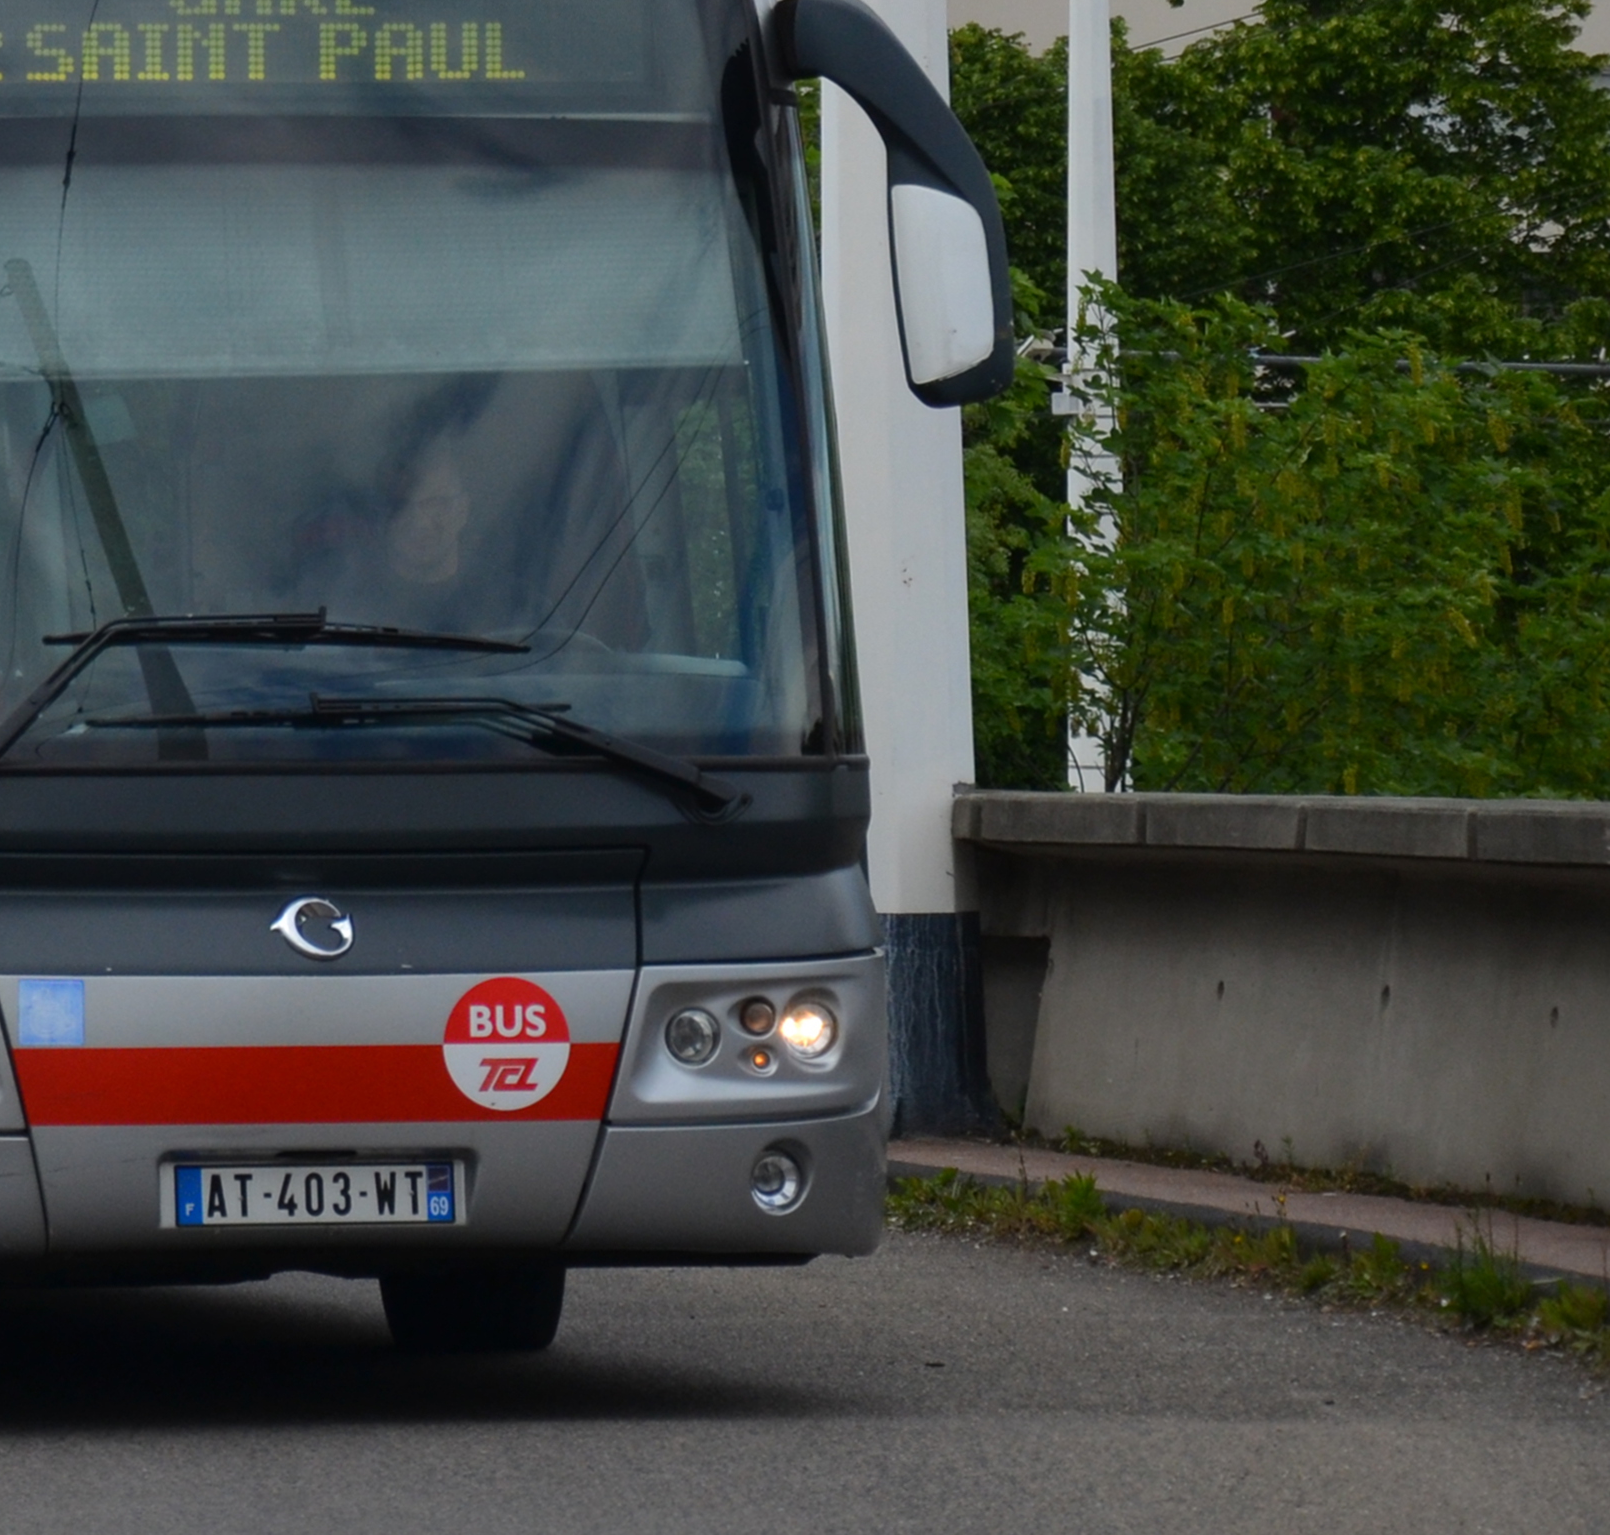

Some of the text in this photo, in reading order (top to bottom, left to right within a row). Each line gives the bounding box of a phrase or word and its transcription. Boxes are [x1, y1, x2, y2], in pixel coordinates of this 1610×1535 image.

[319, 22, 525, 80] PAUL
[469, 1004, 547, 1038] BUS
[479, 1058, 539, 1092] TCL
[185, 1203, 195, 1216] F
[207, 1171, 423, 1217] AT-403-WT
[430, 1196, 449, 1216] 69
